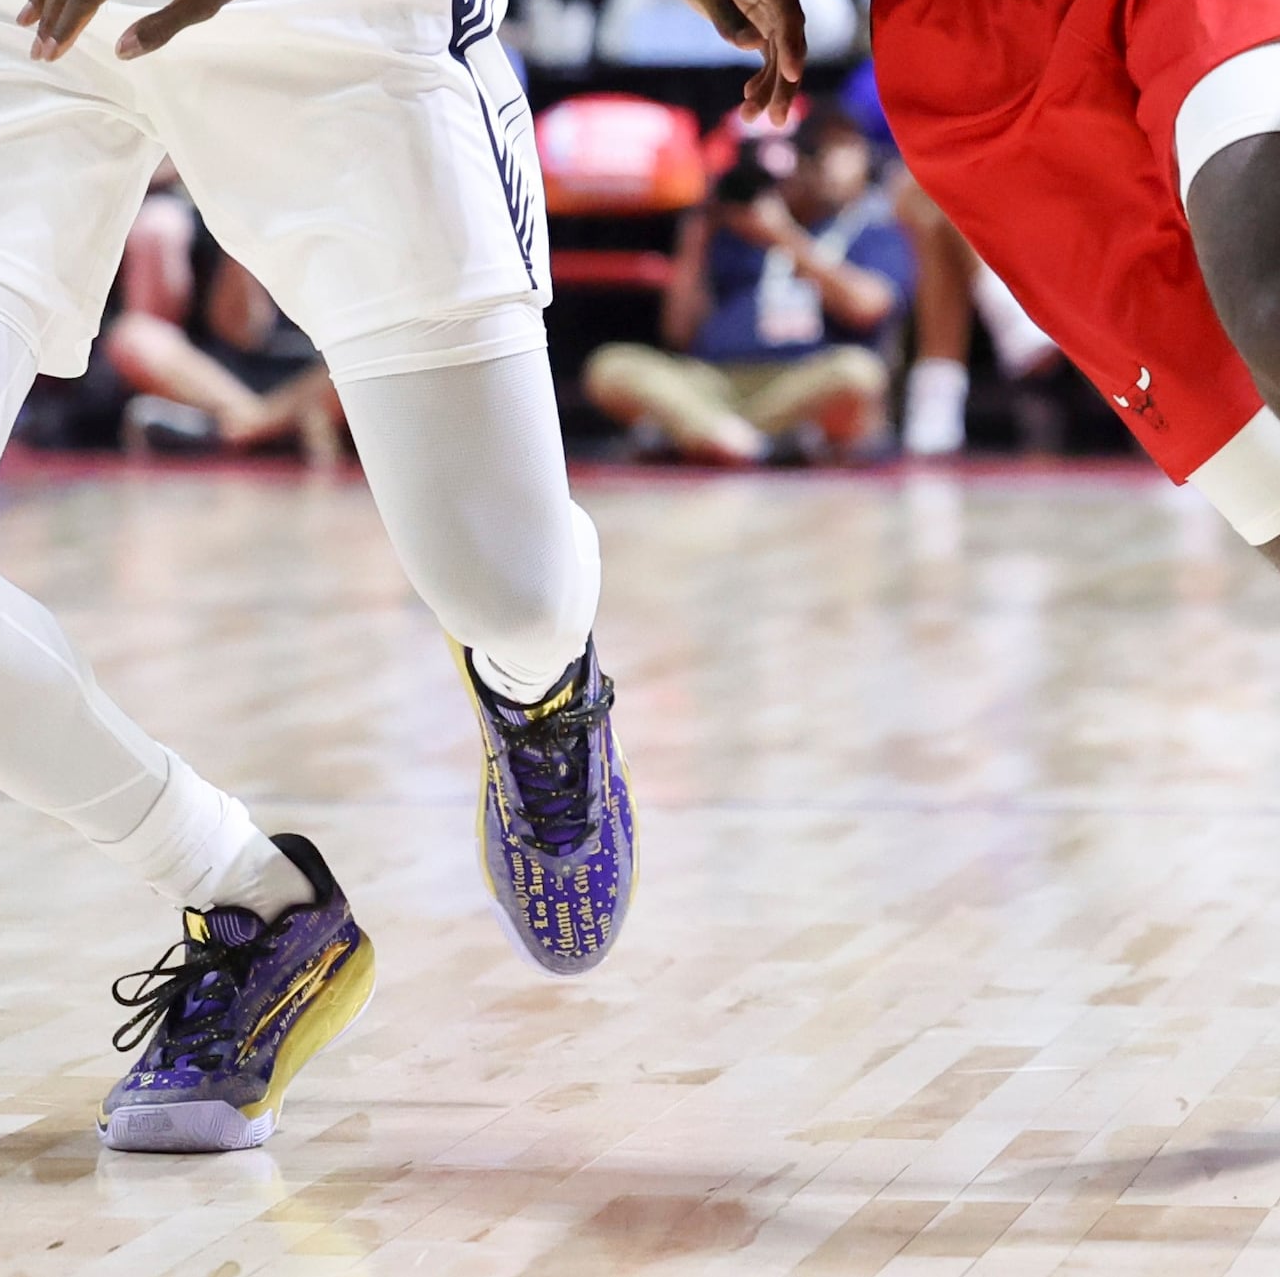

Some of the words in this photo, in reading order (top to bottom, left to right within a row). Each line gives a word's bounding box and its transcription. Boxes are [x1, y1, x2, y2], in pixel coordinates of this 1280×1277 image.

[574, 863, 592, 895] City
[533, 901, 550, 930] Los
[579, 895, 596, 933] Lake
